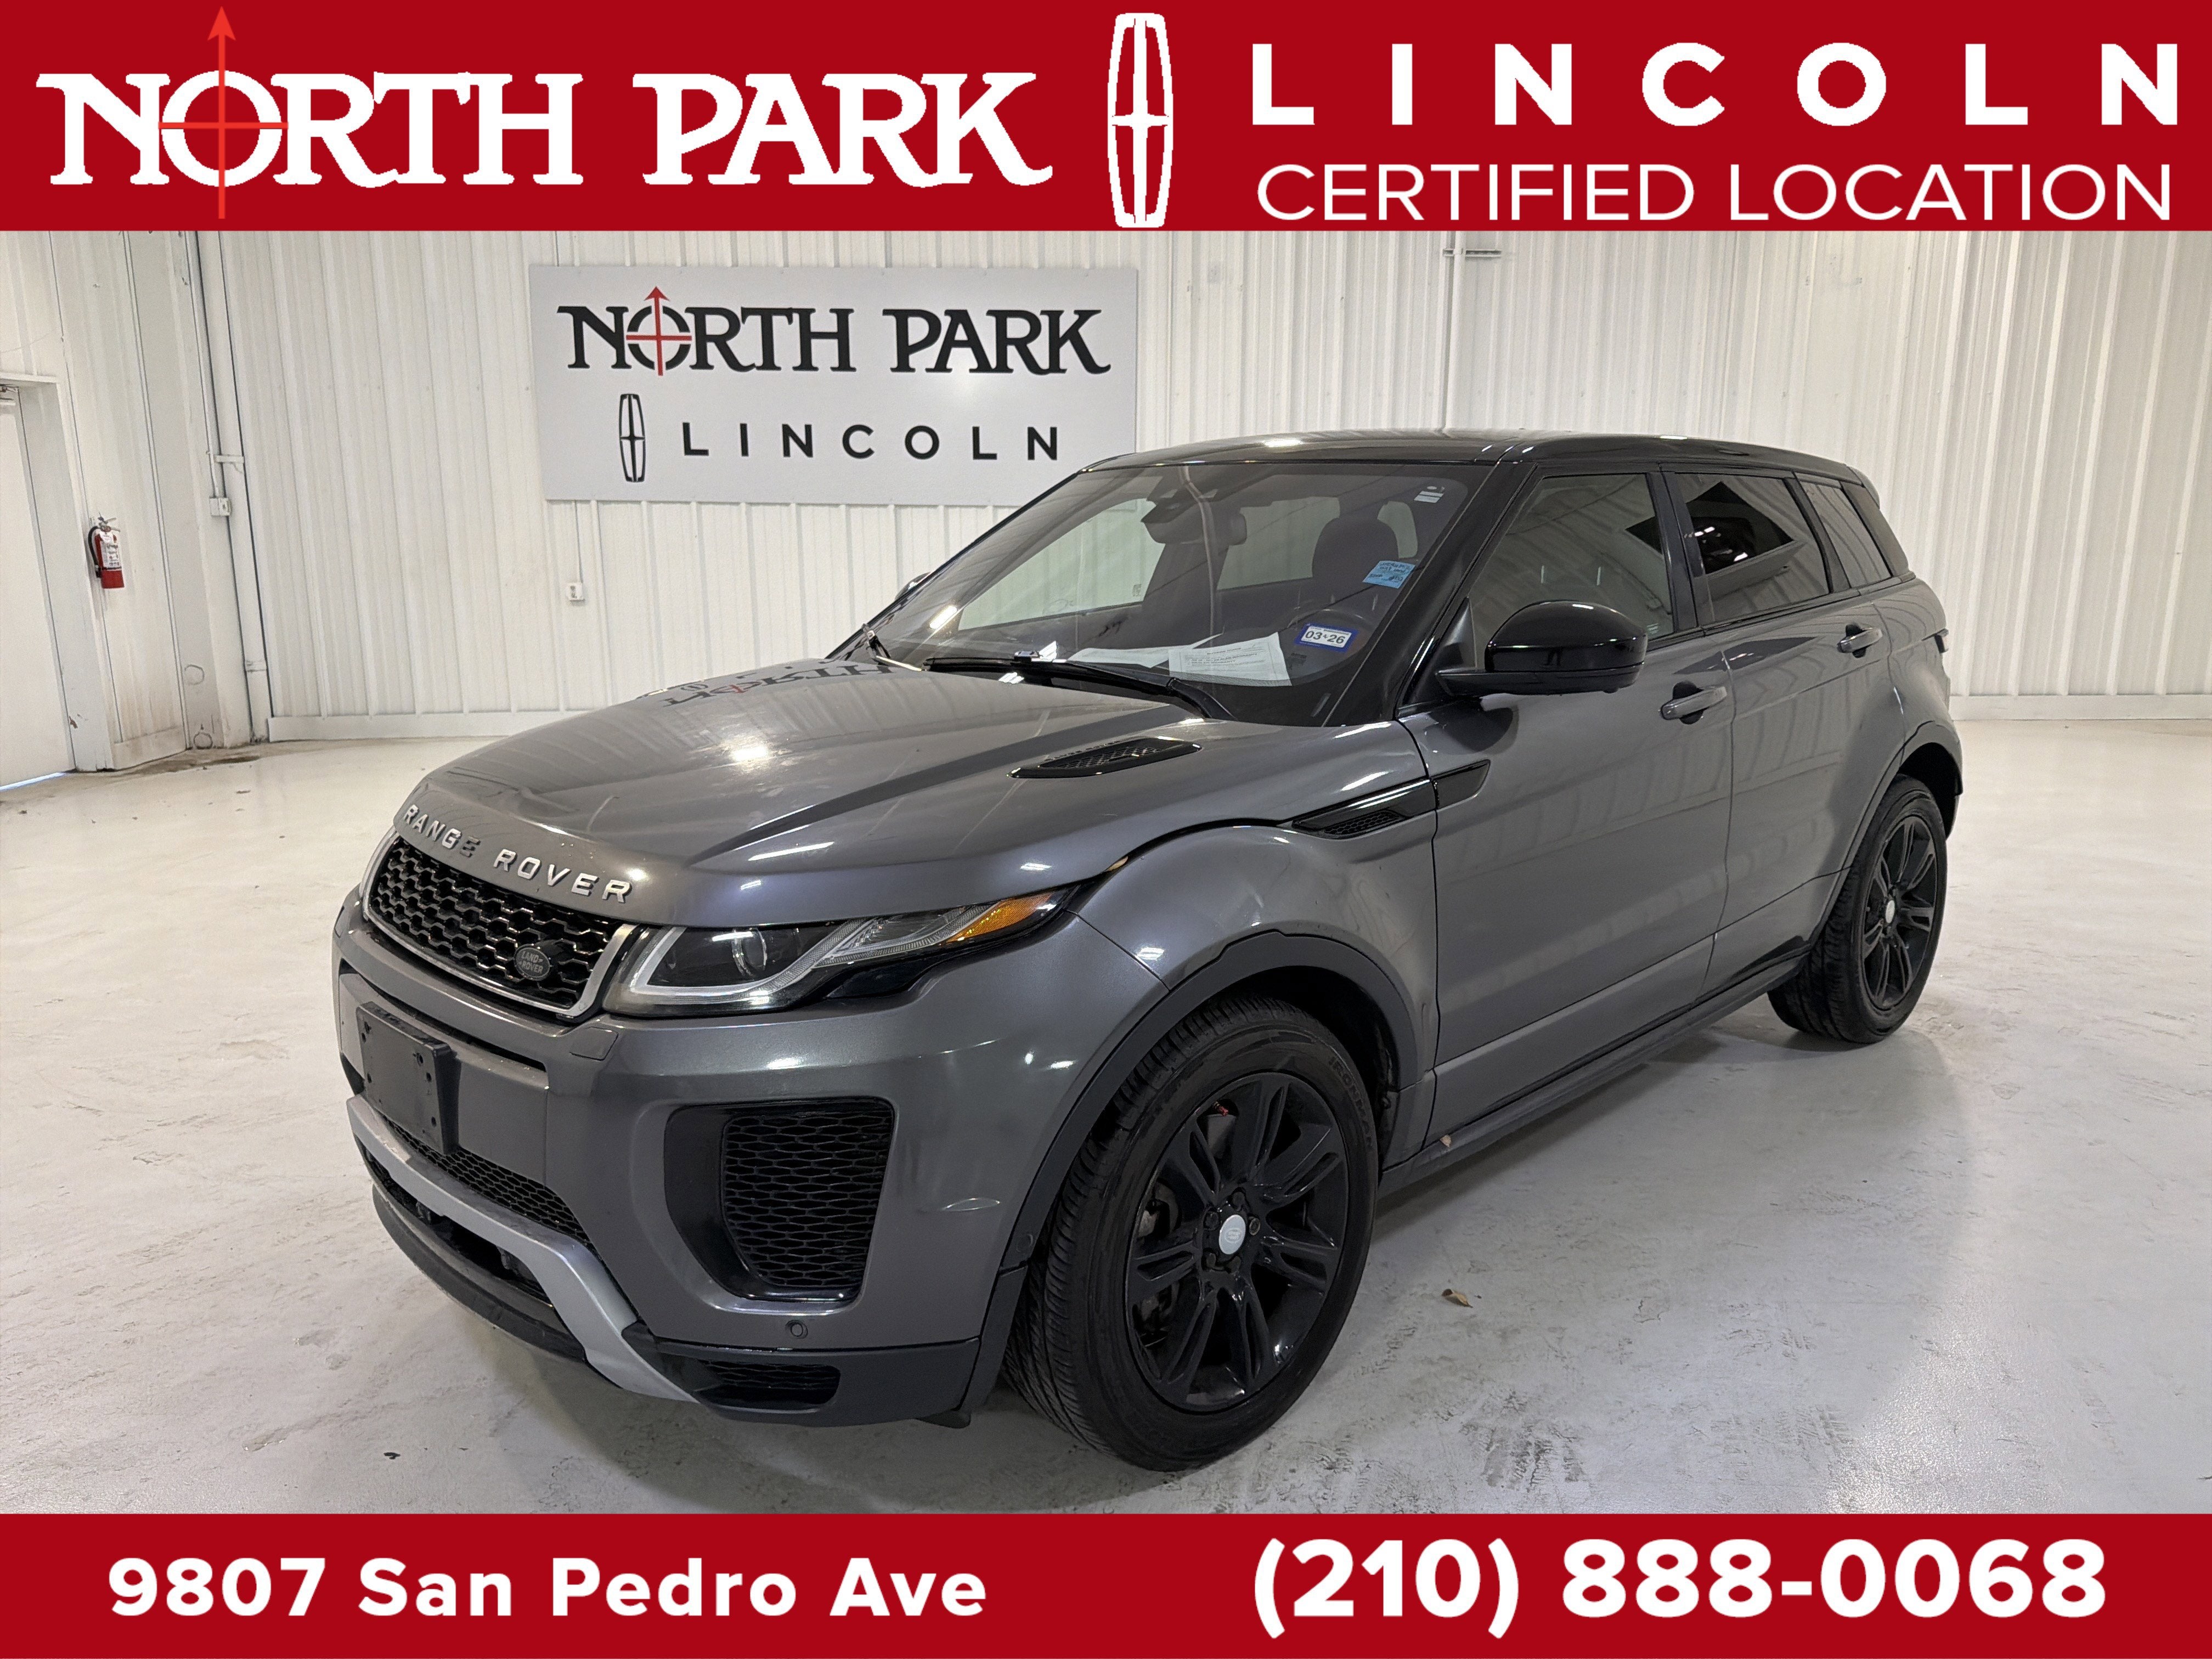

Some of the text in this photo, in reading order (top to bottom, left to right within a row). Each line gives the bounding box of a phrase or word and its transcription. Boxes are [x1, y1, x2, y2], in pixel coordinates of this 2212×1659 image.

[557, 304, 1111, 376] NORTH PARK
[682, 422, 1058, 461] LINCOLN
[1305, 630, 1323, 640] 03
[1327, 634, 1346, 644] 26
[403, 804, 633, 904] RANGE ROVER
[521, 951, 540, 963] LAND
[522, 960, 544, 974] ROVER
